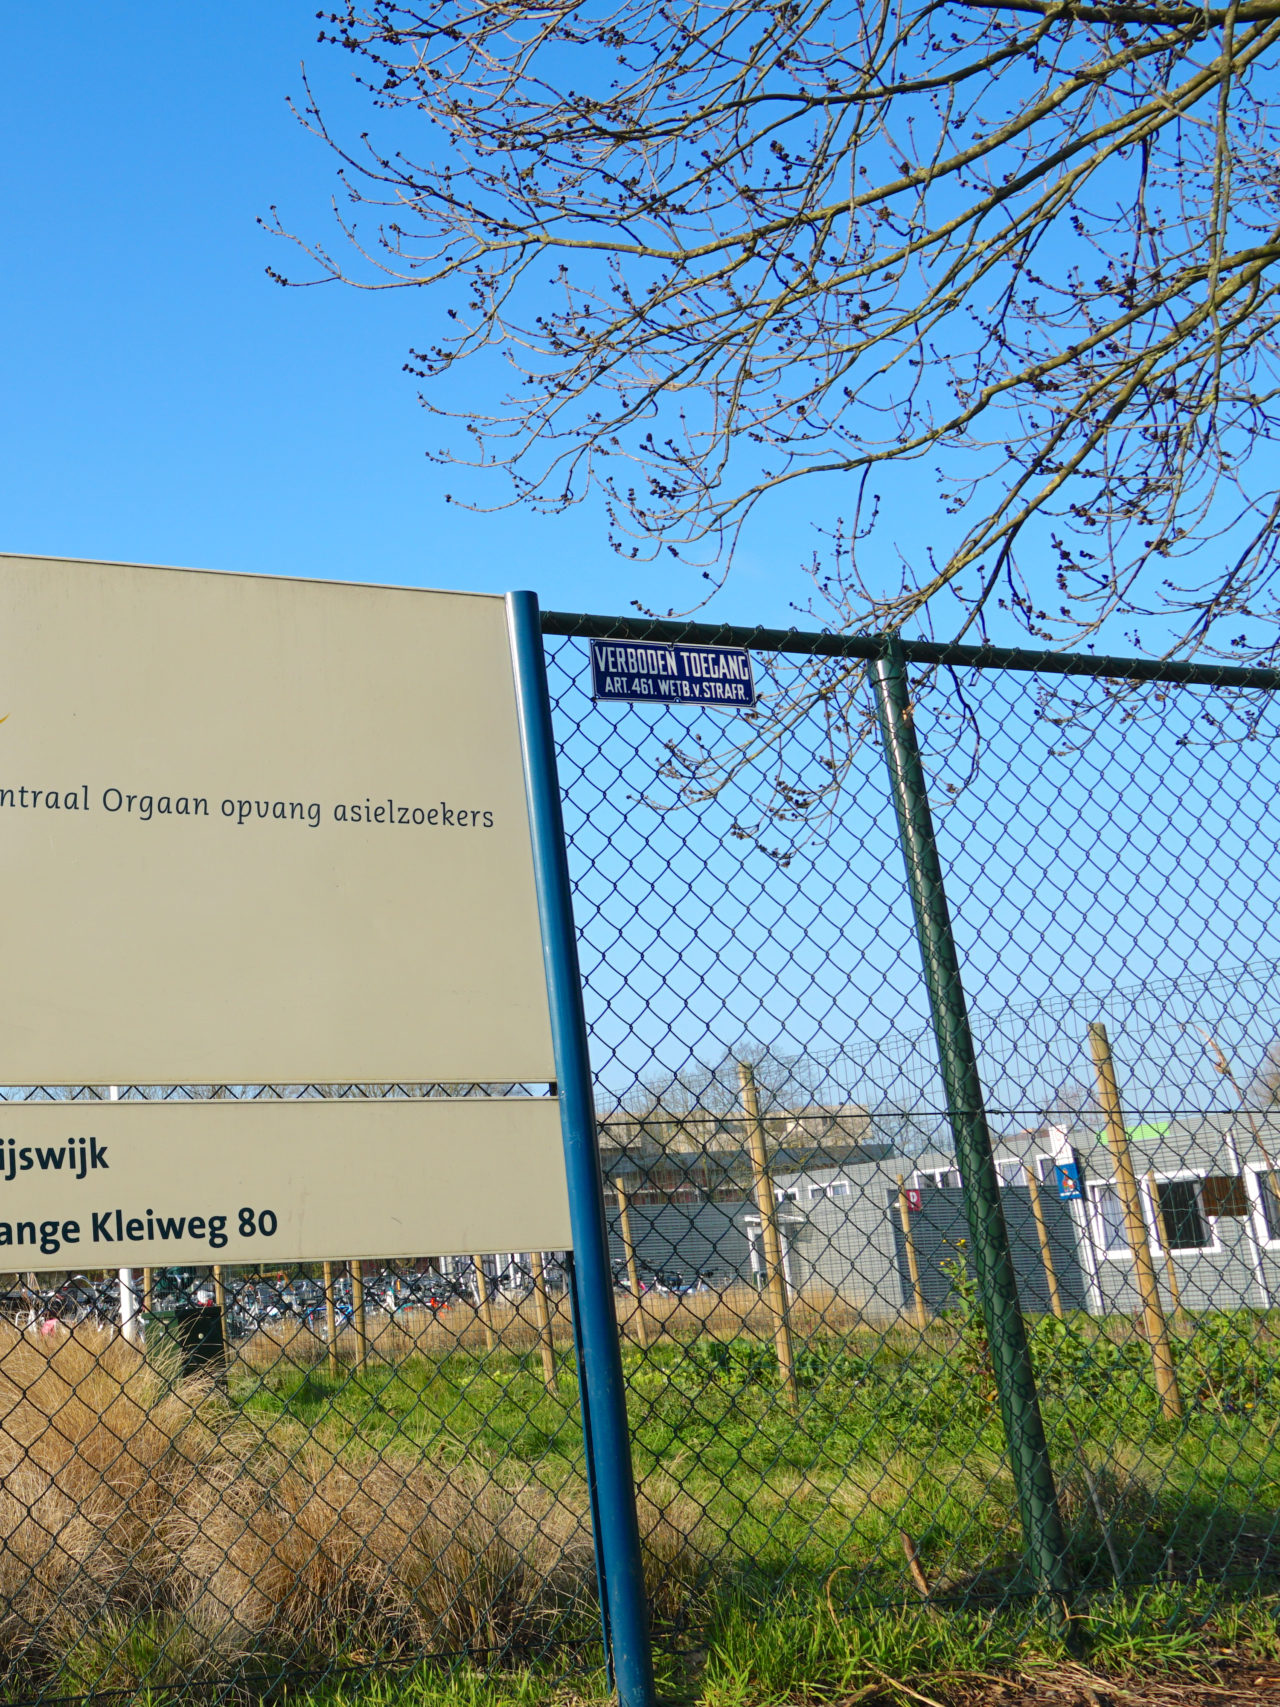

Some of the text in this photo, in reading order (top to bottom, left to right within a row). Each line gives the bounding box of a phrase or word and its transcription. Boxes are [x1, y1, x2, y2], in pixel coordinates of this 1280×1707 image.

[594, 646, 750, 680] VERBODEN TOEGANG
[102, 788, 210, 821] Orgaan
[221, 798, 321, 828] opvang
[334, 798, 494, 828] asielzoekers
[91, 1208, 229, 1249] Kleiweg
[238, 1207, 278, 1238] 80
